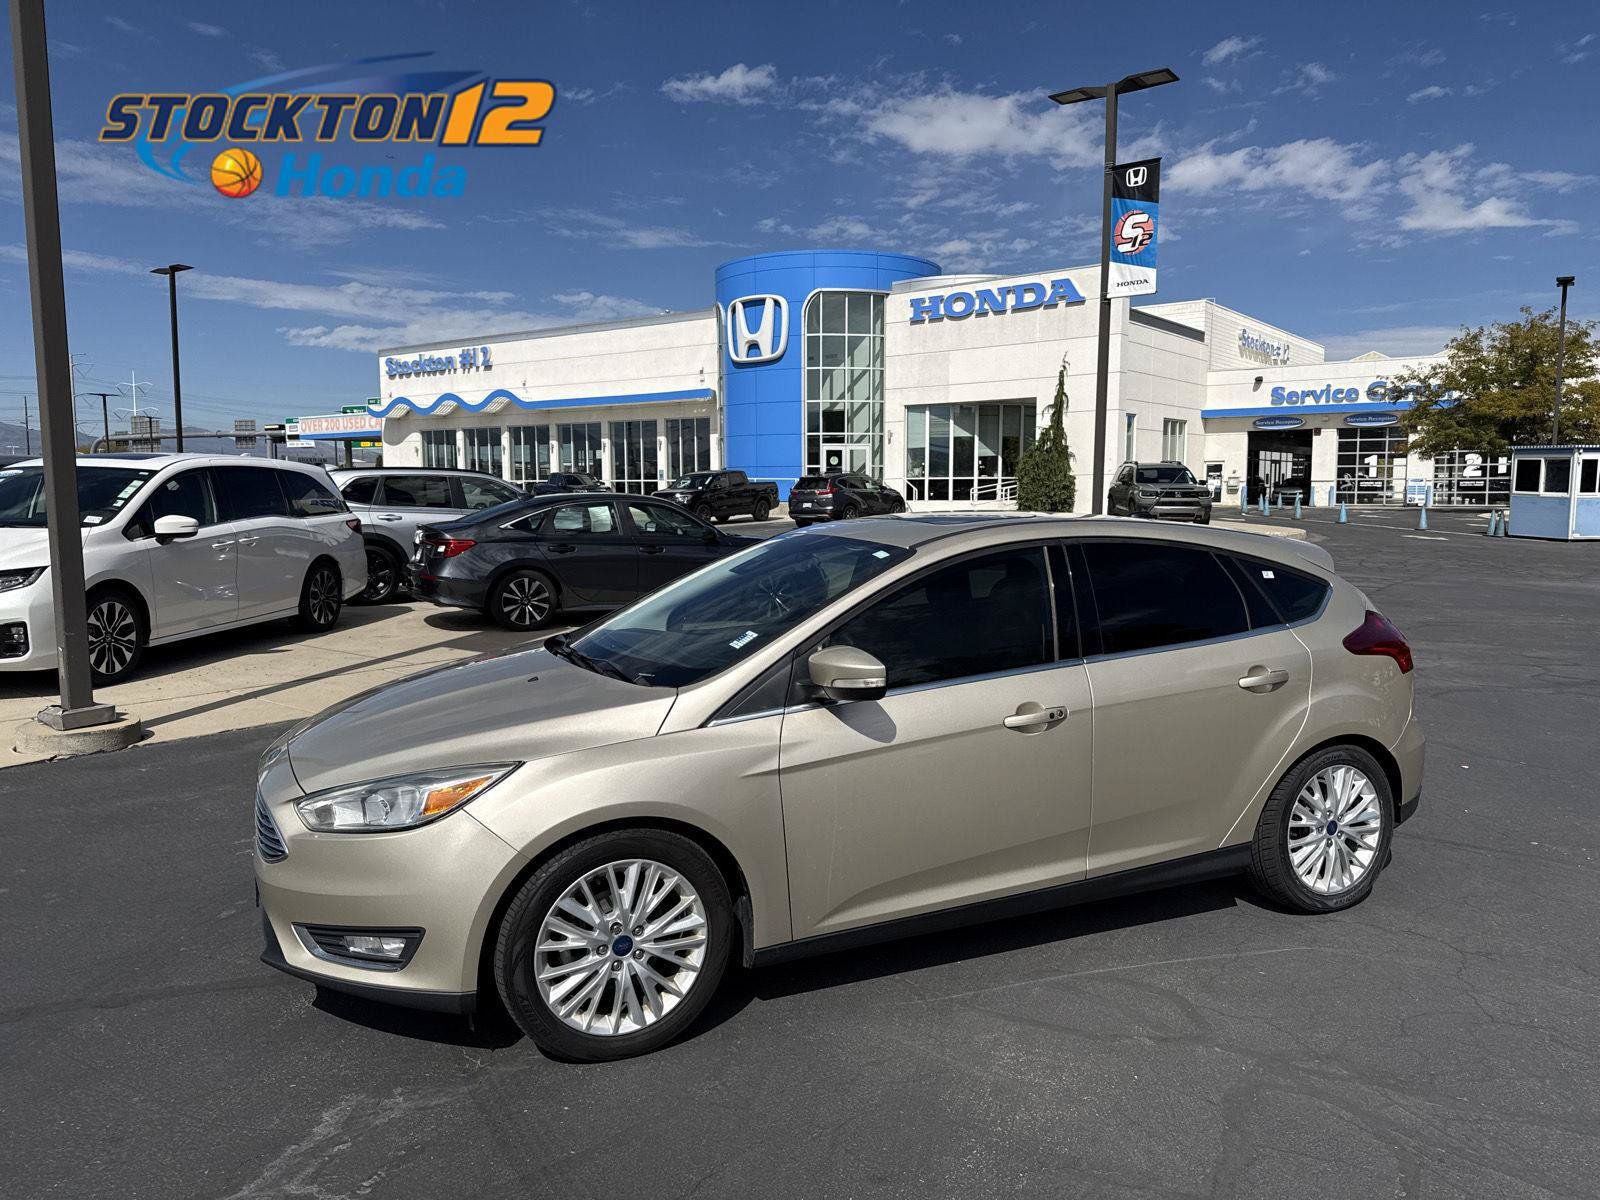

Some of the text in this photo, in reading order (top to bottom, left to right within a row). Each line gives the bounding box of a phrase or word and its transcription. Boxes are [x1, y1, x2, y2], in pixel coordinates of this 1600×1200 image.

[1116, 278, 1150, 288] HONDA
[909, 277, 1086, 326] HONDA
[385, 354, 456, 377] Stockton
[1270, 383, 1360, 405] Service
[300, 419, 324, 432] OVER
[324, 418, 341, 431] 200
[342, 416, 367, 430] USED
[1364, 455, 1378, 478] 1
[1462, 453, 1483, 477] 2
